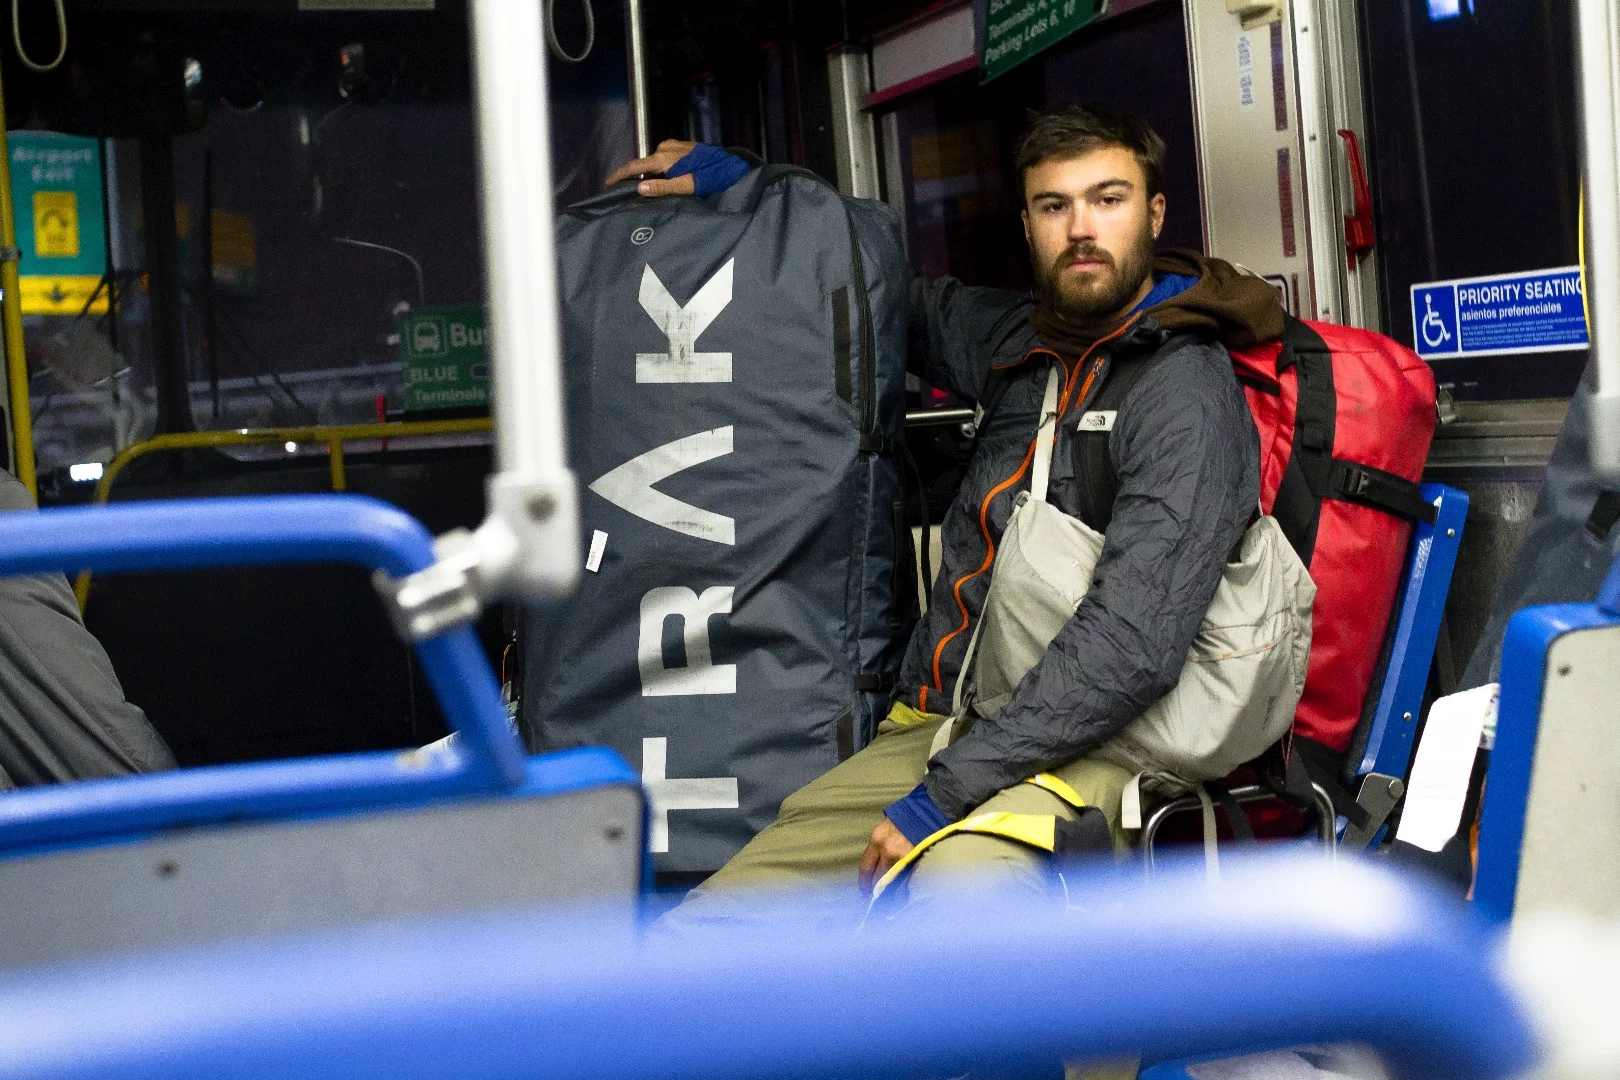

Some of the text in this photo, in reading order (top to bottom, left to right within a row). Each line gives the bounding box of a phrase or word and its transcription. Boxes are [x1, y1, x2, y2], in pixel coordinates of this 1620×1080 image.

[985, 34, 1023, 65] Parking
[1025, 18, 1047, 41] Lots
[13, 147, 92, 163] Airport
[1459, 283, 1520, 306] PRIORITY
[1461, 302, 1562, 321] asientos preferenciales
[410, 365, 458, 381] BLUE
